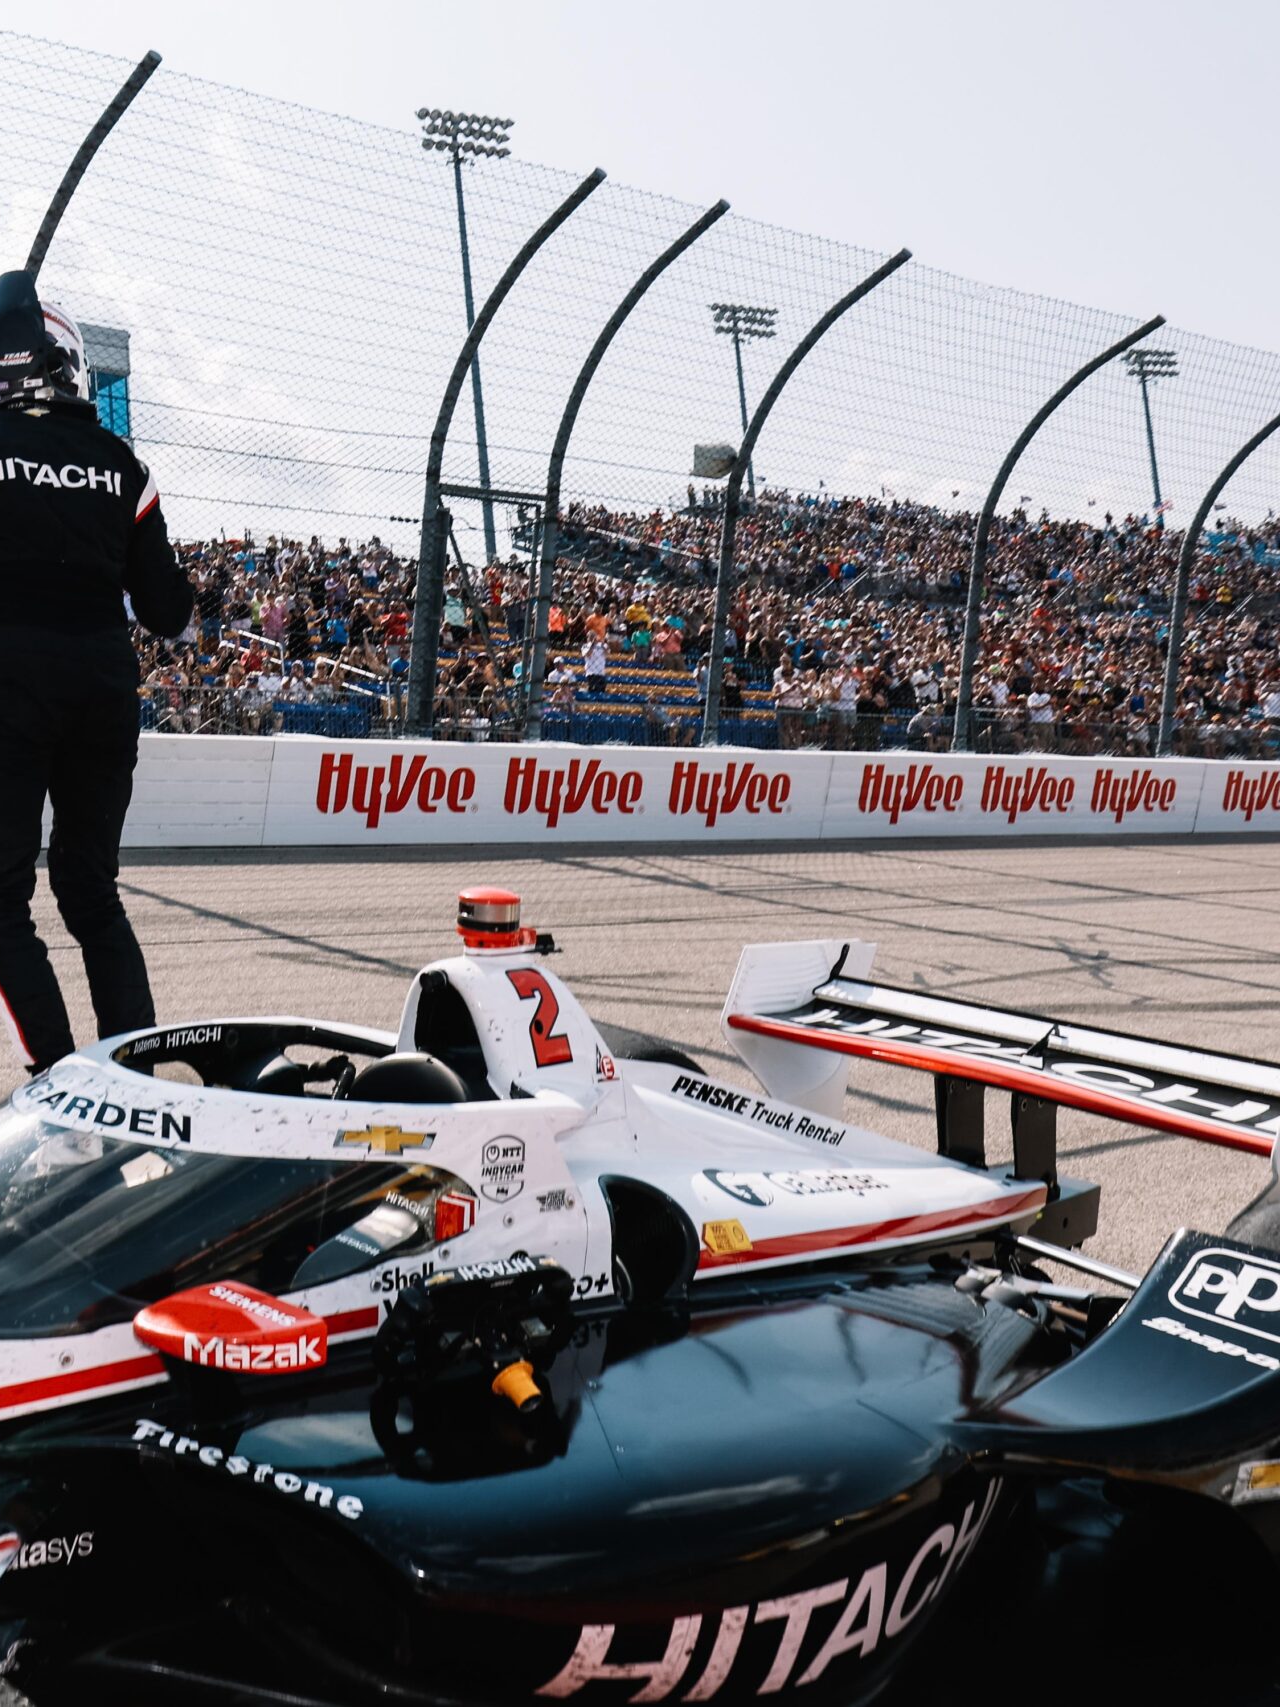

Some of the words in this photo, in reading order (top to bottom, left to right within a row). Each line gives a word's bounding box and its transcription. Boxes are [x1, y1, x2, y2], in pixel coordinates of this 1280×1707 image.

[505, 967, 574, 1068] 2
[166, 1025, 222, 1049] HITACHI
[671, 1075, 751, 1115] PENSKE
[751, 1101, 794, 1133] Truck
[794, 1116, 847, 1147] Rental
[502, 1146, 522, 1158] NTT
[482, 1164, 524, 1177] INDYCAR
[386, 1190, 430, 1217] HITACHI
[458, 1256, 536, 1282] HITACHI
[208, 1286, 296, 1328] SIEMENS
[183, 1334, 321, 1370] Mazak
[132, 1419, 364, 1520] Firestone
[534, 1476, 1004, 1703] HITACHI
